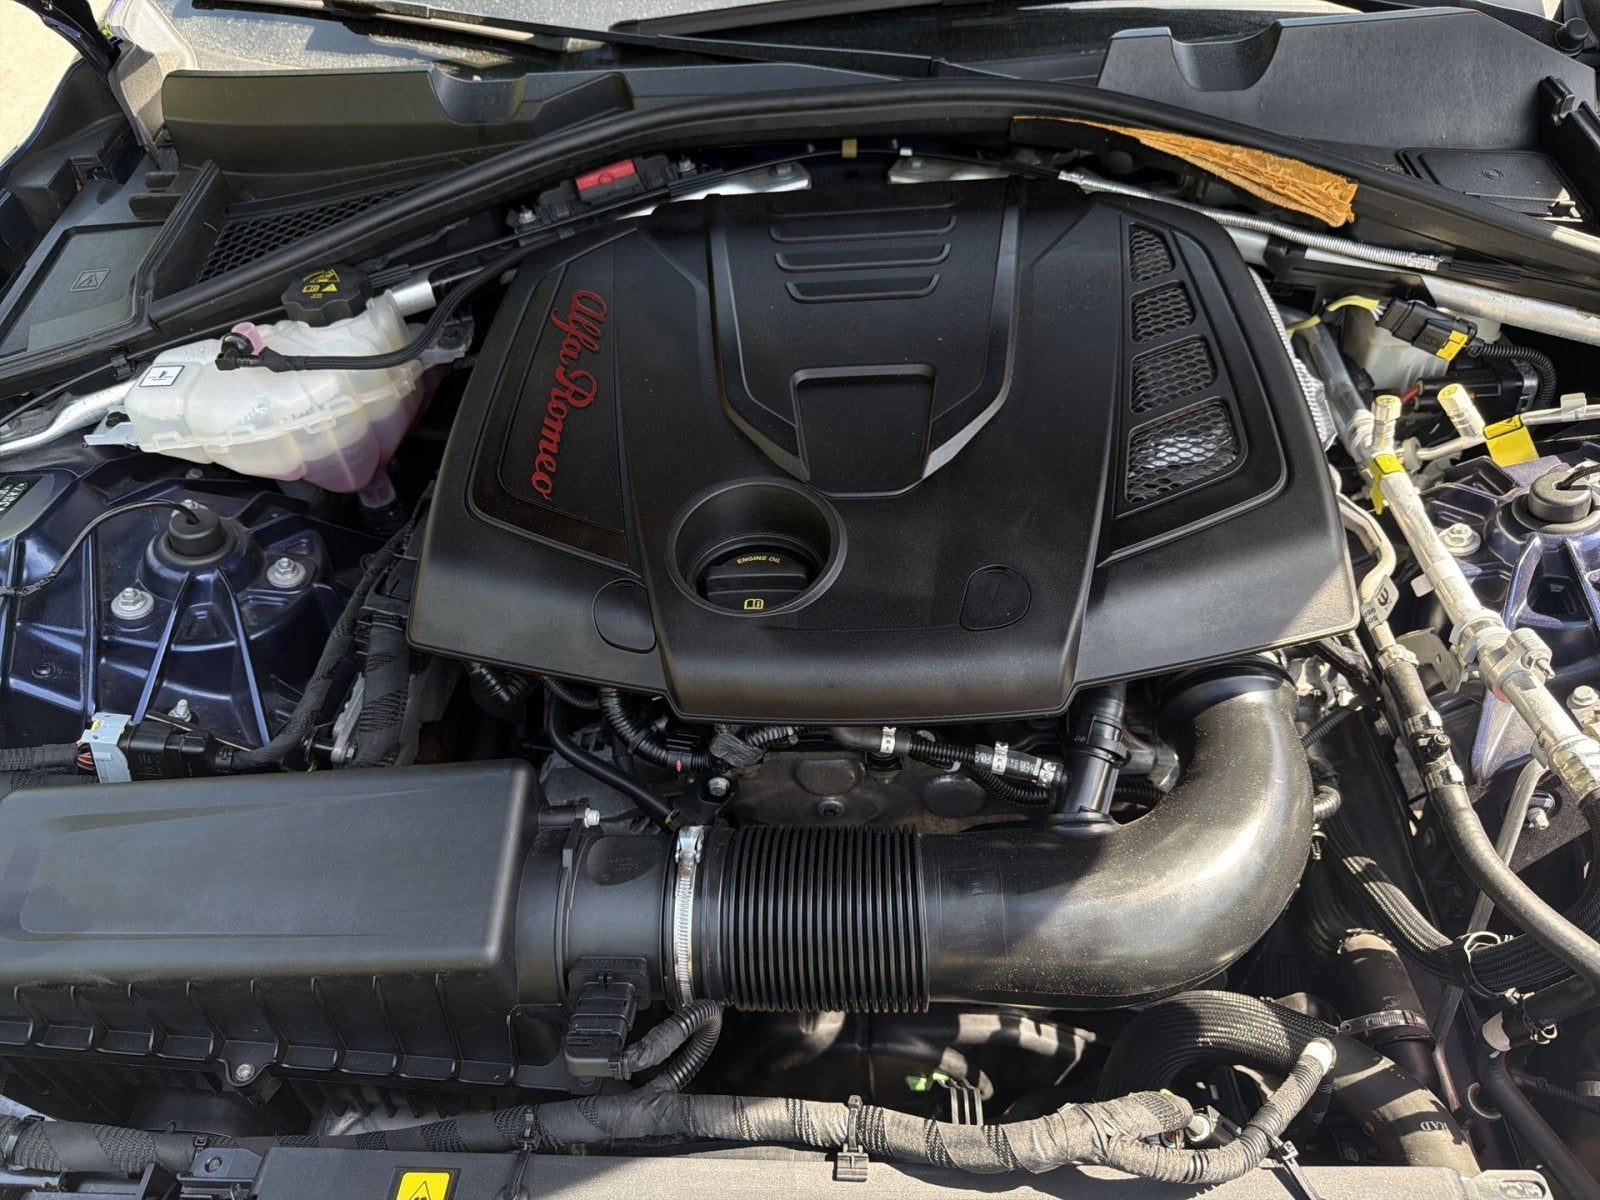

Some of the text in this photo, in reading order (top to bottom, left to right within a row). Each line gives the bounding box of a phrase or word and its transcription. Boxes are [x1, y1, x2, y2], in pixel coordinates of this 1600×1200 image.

[531, 289, 608, 500] Alfa Romeo
[736, 555, 781, 564] ENGINE OIL
